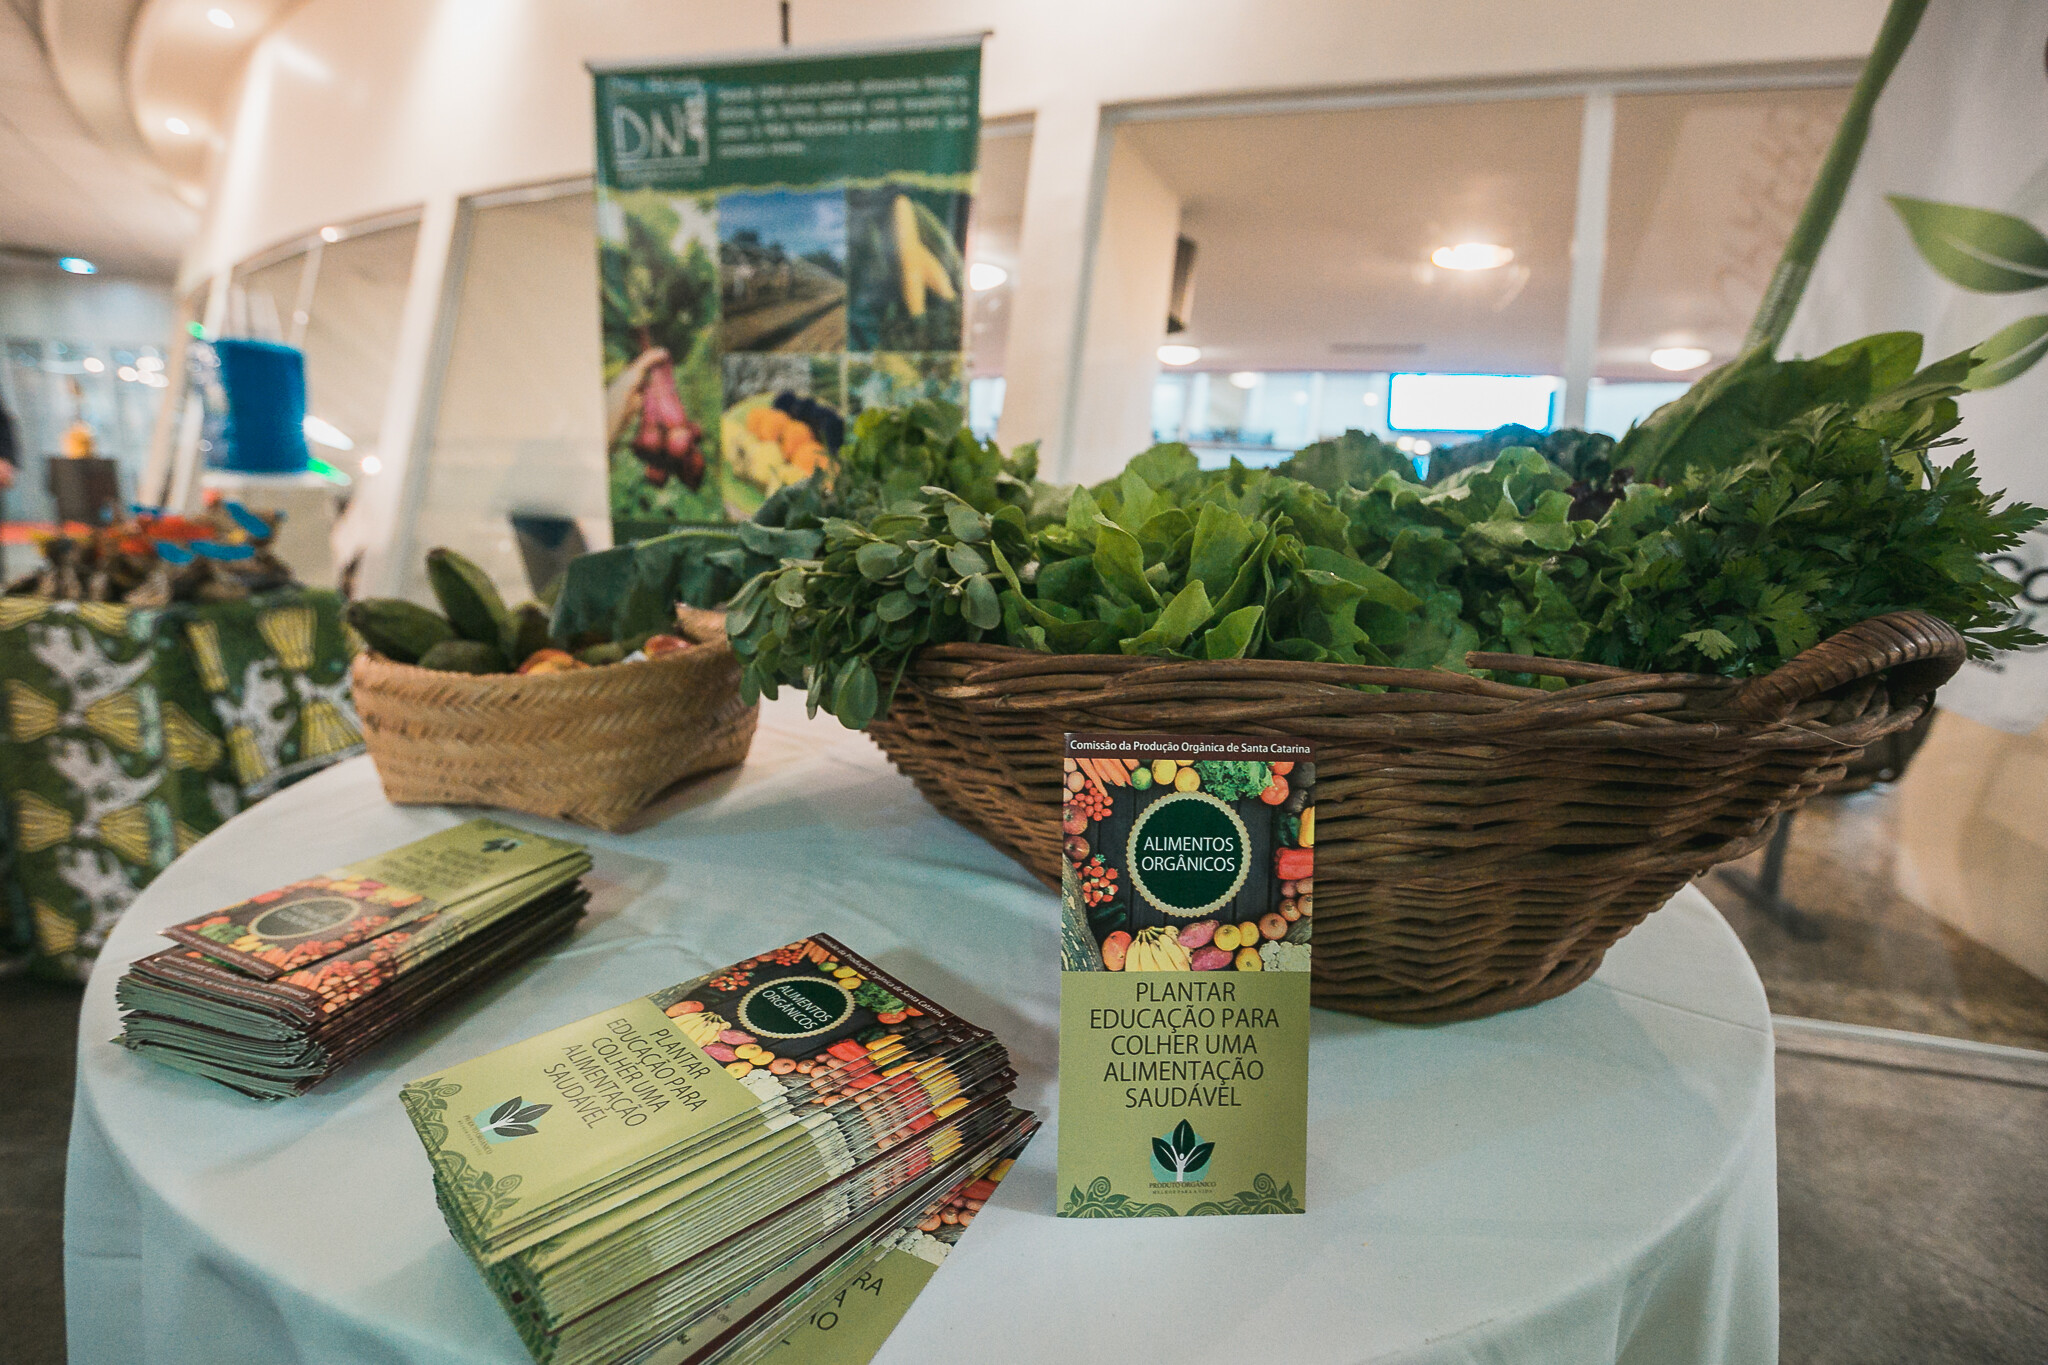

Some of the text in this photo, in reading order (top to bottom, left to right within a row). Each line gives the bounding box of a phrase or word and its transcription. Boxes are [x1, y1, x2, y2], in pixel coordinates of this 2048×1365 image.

[1070, 740, 1311, 755] Comissão da Produção Orgânica de Santa Catarina
[1143, 837, 1234, 852] ALIMENTOS
[1141, 854, 1236, 872] ORGÂNICOS
[847, 953, 871, 973] Produção
[869, 969, 895, 988] Orgânica
[901, 990, 919, 1003] Santa
[918, 1000, 945, 1018] Catarina
[1136, 982, 1236, 1002] PLANTAR
[762, 990, 818, 1030] ORGÂNICOS
[777, 985, 833, 1022] ALIMENTOS
[1090, 1004, 1279, 1033] EDUCAÇÃO PARA
[649, 1028, 711, 1080] PLANTAR
[1111, 1034, 1258, 1056] COLHER UMA
[591, 1037, 670, 1113] COLHER UMA
[606, 1018, 708, 1112] EDUCAÇÃO PARA
[1103, 1057, 1264, 1085] ALIMENTAÇÃO
[543, 1063, 608, 1129] SAUDÁVEL
[562, 1044, 648, 1127] ALIMENTAÇÃO
[1125, 1083, 1242, 1108] SAUDÁVEL
[852, 1271, 884, 1296] RA
